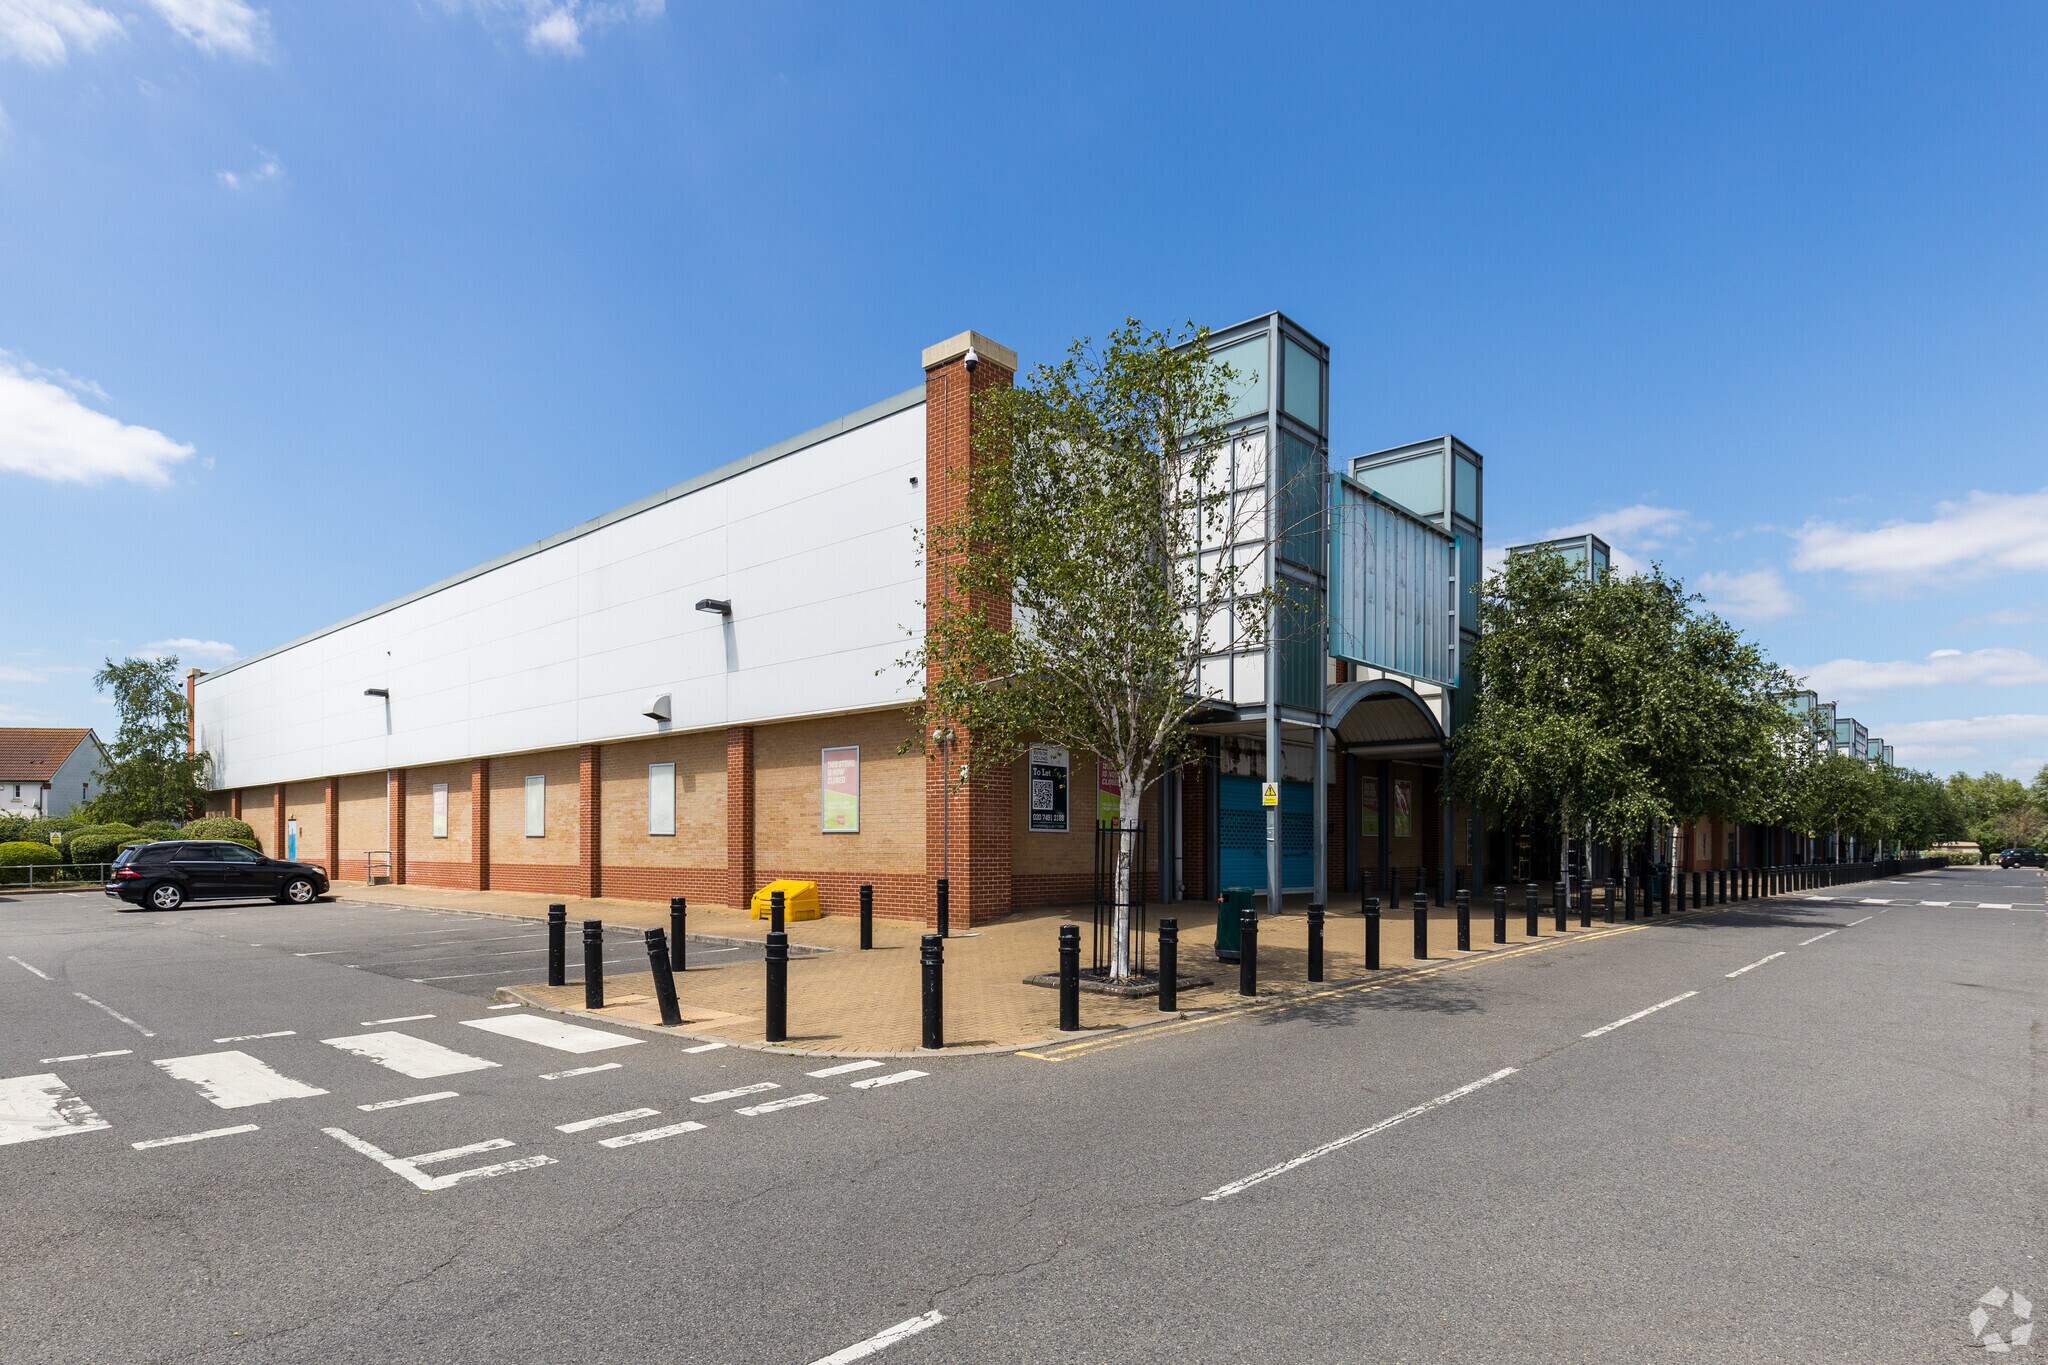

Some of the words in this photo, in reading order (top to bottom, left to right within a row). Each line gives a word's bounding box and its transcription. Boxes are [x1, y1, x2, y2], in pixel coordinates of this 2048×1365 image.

[828, 761, 838, 769] THIS
[838, 760, 855, 768] STORE
[827, 769, 832, 777] IS
[832, 768, 845, 776] NOW
[1033, 768, 1041, 776] To
[1041, 768, 1051, 777] Let
[828, 777, 846, 785] CLOSED
[1102, 778, 1119, 786] CLOSE
[1033, 813, 1041, 821] 020
[1053, 814, 1065, 822] 2188
